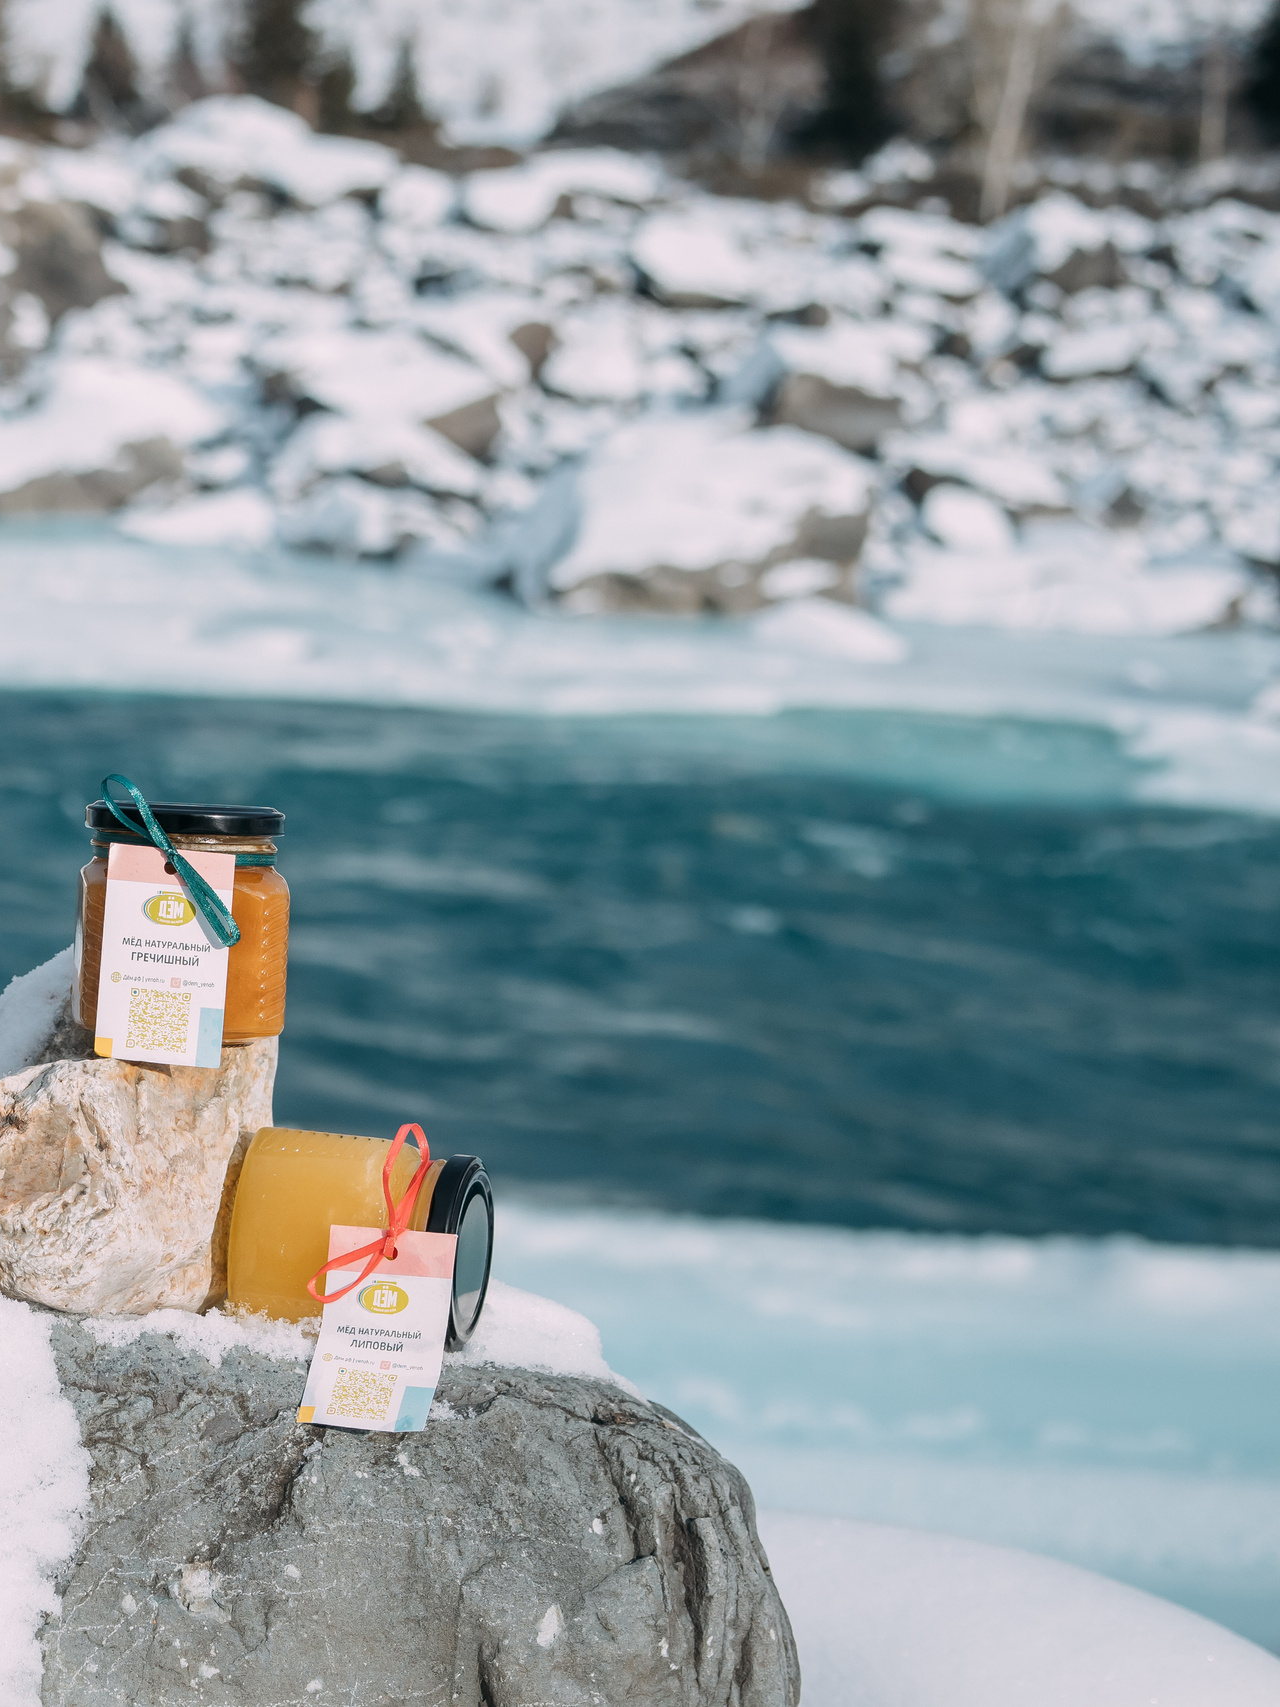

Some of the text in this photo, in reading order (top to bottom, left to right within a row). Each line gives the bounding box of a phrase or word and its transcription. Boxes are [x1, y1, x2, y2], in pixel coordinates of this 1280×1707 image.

[122, 936, 211, 953] МЁД НАТУРАЛЬНЫЙ
[131, 951, 200, 967] ГРЕЧИШНЫЙ
[336, 1325, 422, 1340] МЁД НАТУРАЛЬНЫЙ
[350, 1339, 404, 1353] ЛИПОВЫЙ
